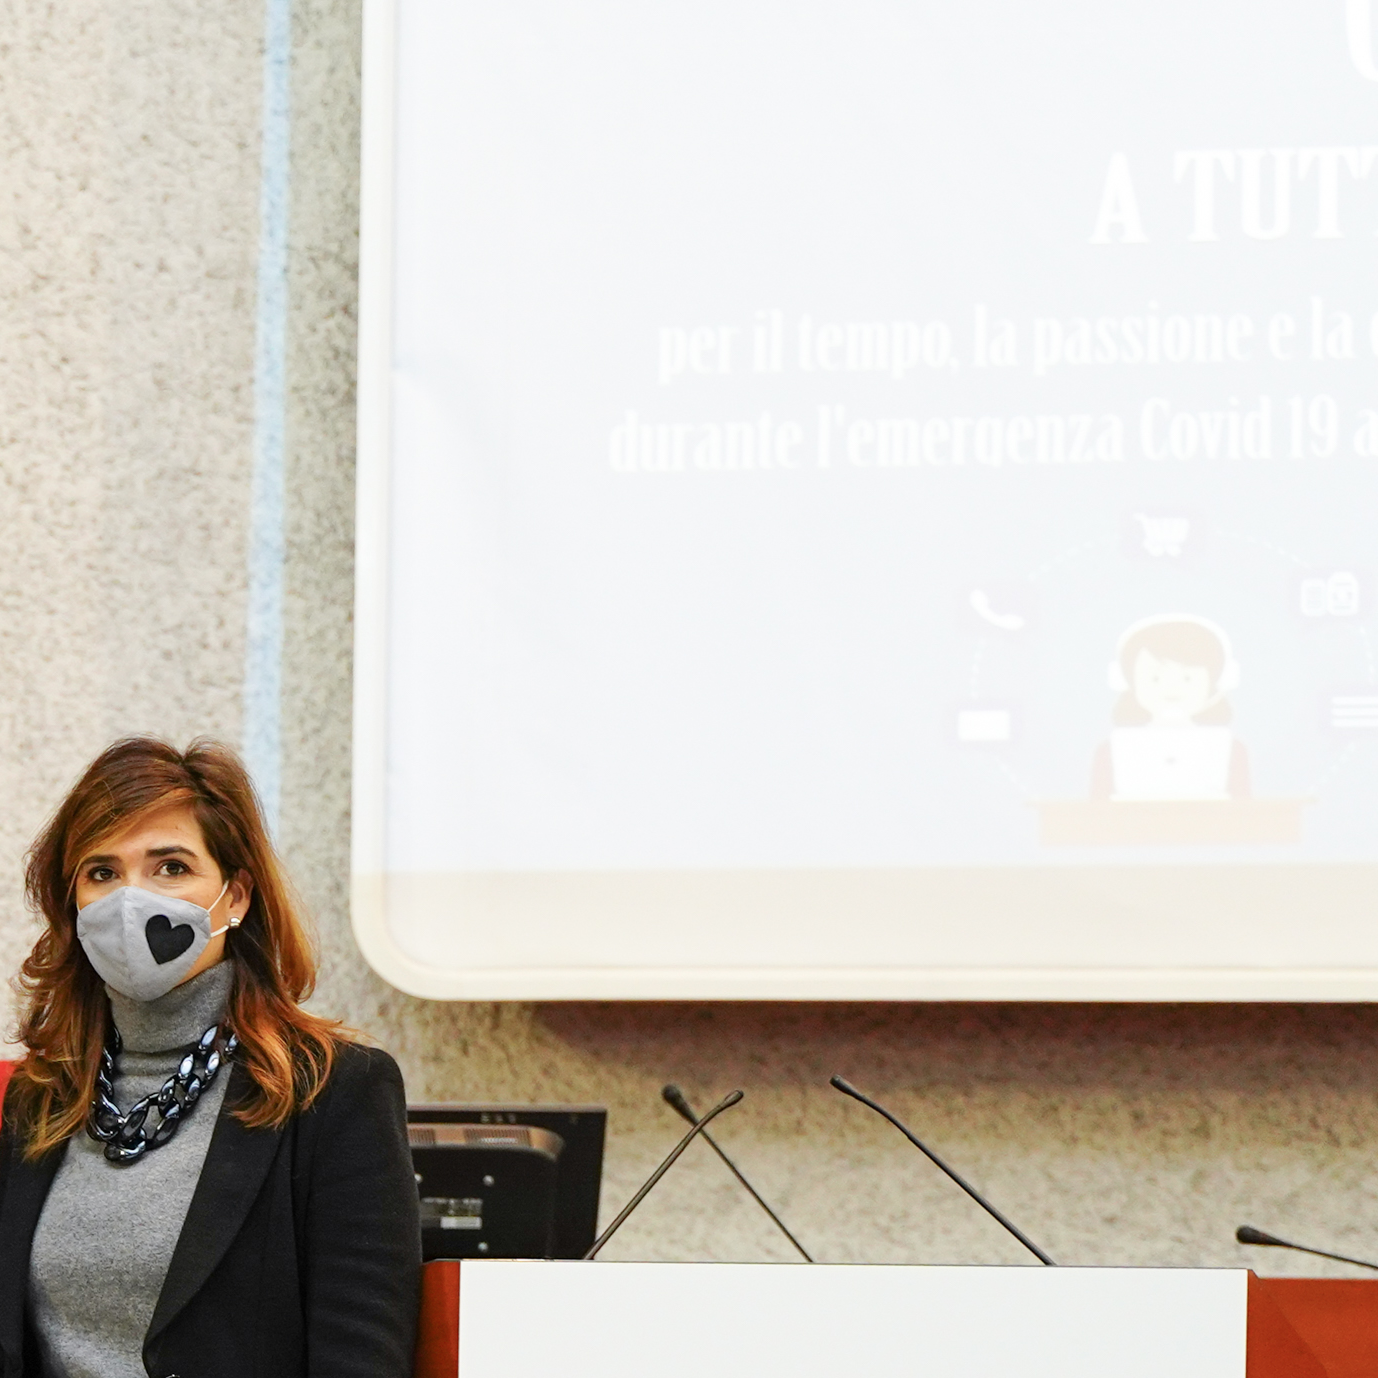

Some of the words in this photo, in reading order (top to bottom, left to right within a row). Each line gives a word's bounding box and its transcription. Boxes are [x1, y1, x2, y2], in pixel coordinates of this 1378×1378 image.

[1088, 150, 1150, 244] A
[657, 324, 741, 386] per
[752, 307, 785, 373] il
[798, 312, 960, 381] tempo,
[973, 302, 1019, 368] la
[1033, 299, 1255, 377] passione
[1267, 312, 1295, 361] e
[1310, 295, 1357, 361] la
[608, 408, 804, 473] durante
[817, 403, 1125, 468] l'emergenza
[1139, 394, 1273, 462] Covid
[1288, 393, 1339, 459] 19
